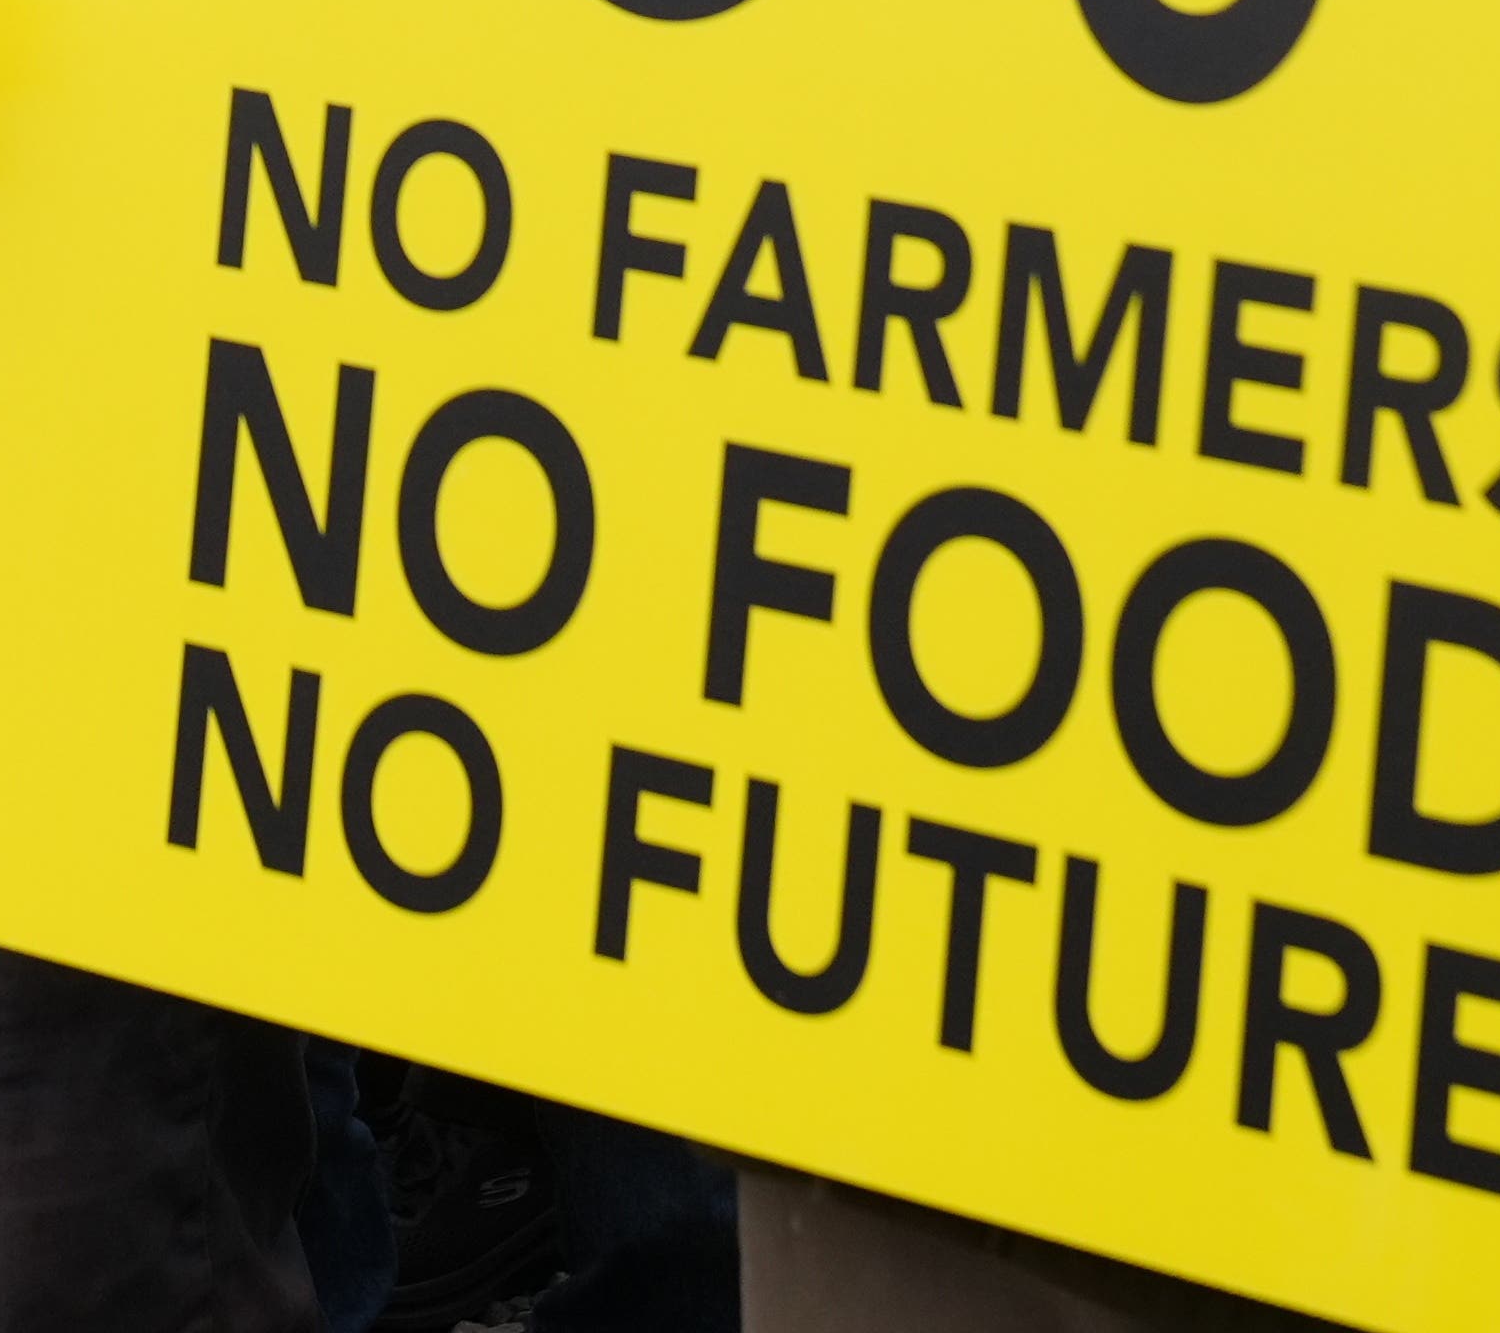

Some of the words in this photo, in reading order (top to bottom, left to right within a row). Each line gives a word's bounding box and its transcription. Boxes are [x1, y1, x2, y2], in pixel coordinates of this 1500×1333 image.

[215, 85, 515, 314] NO
[186, 336, 598, 659] NO
[165, 641, 505, 917] NO
